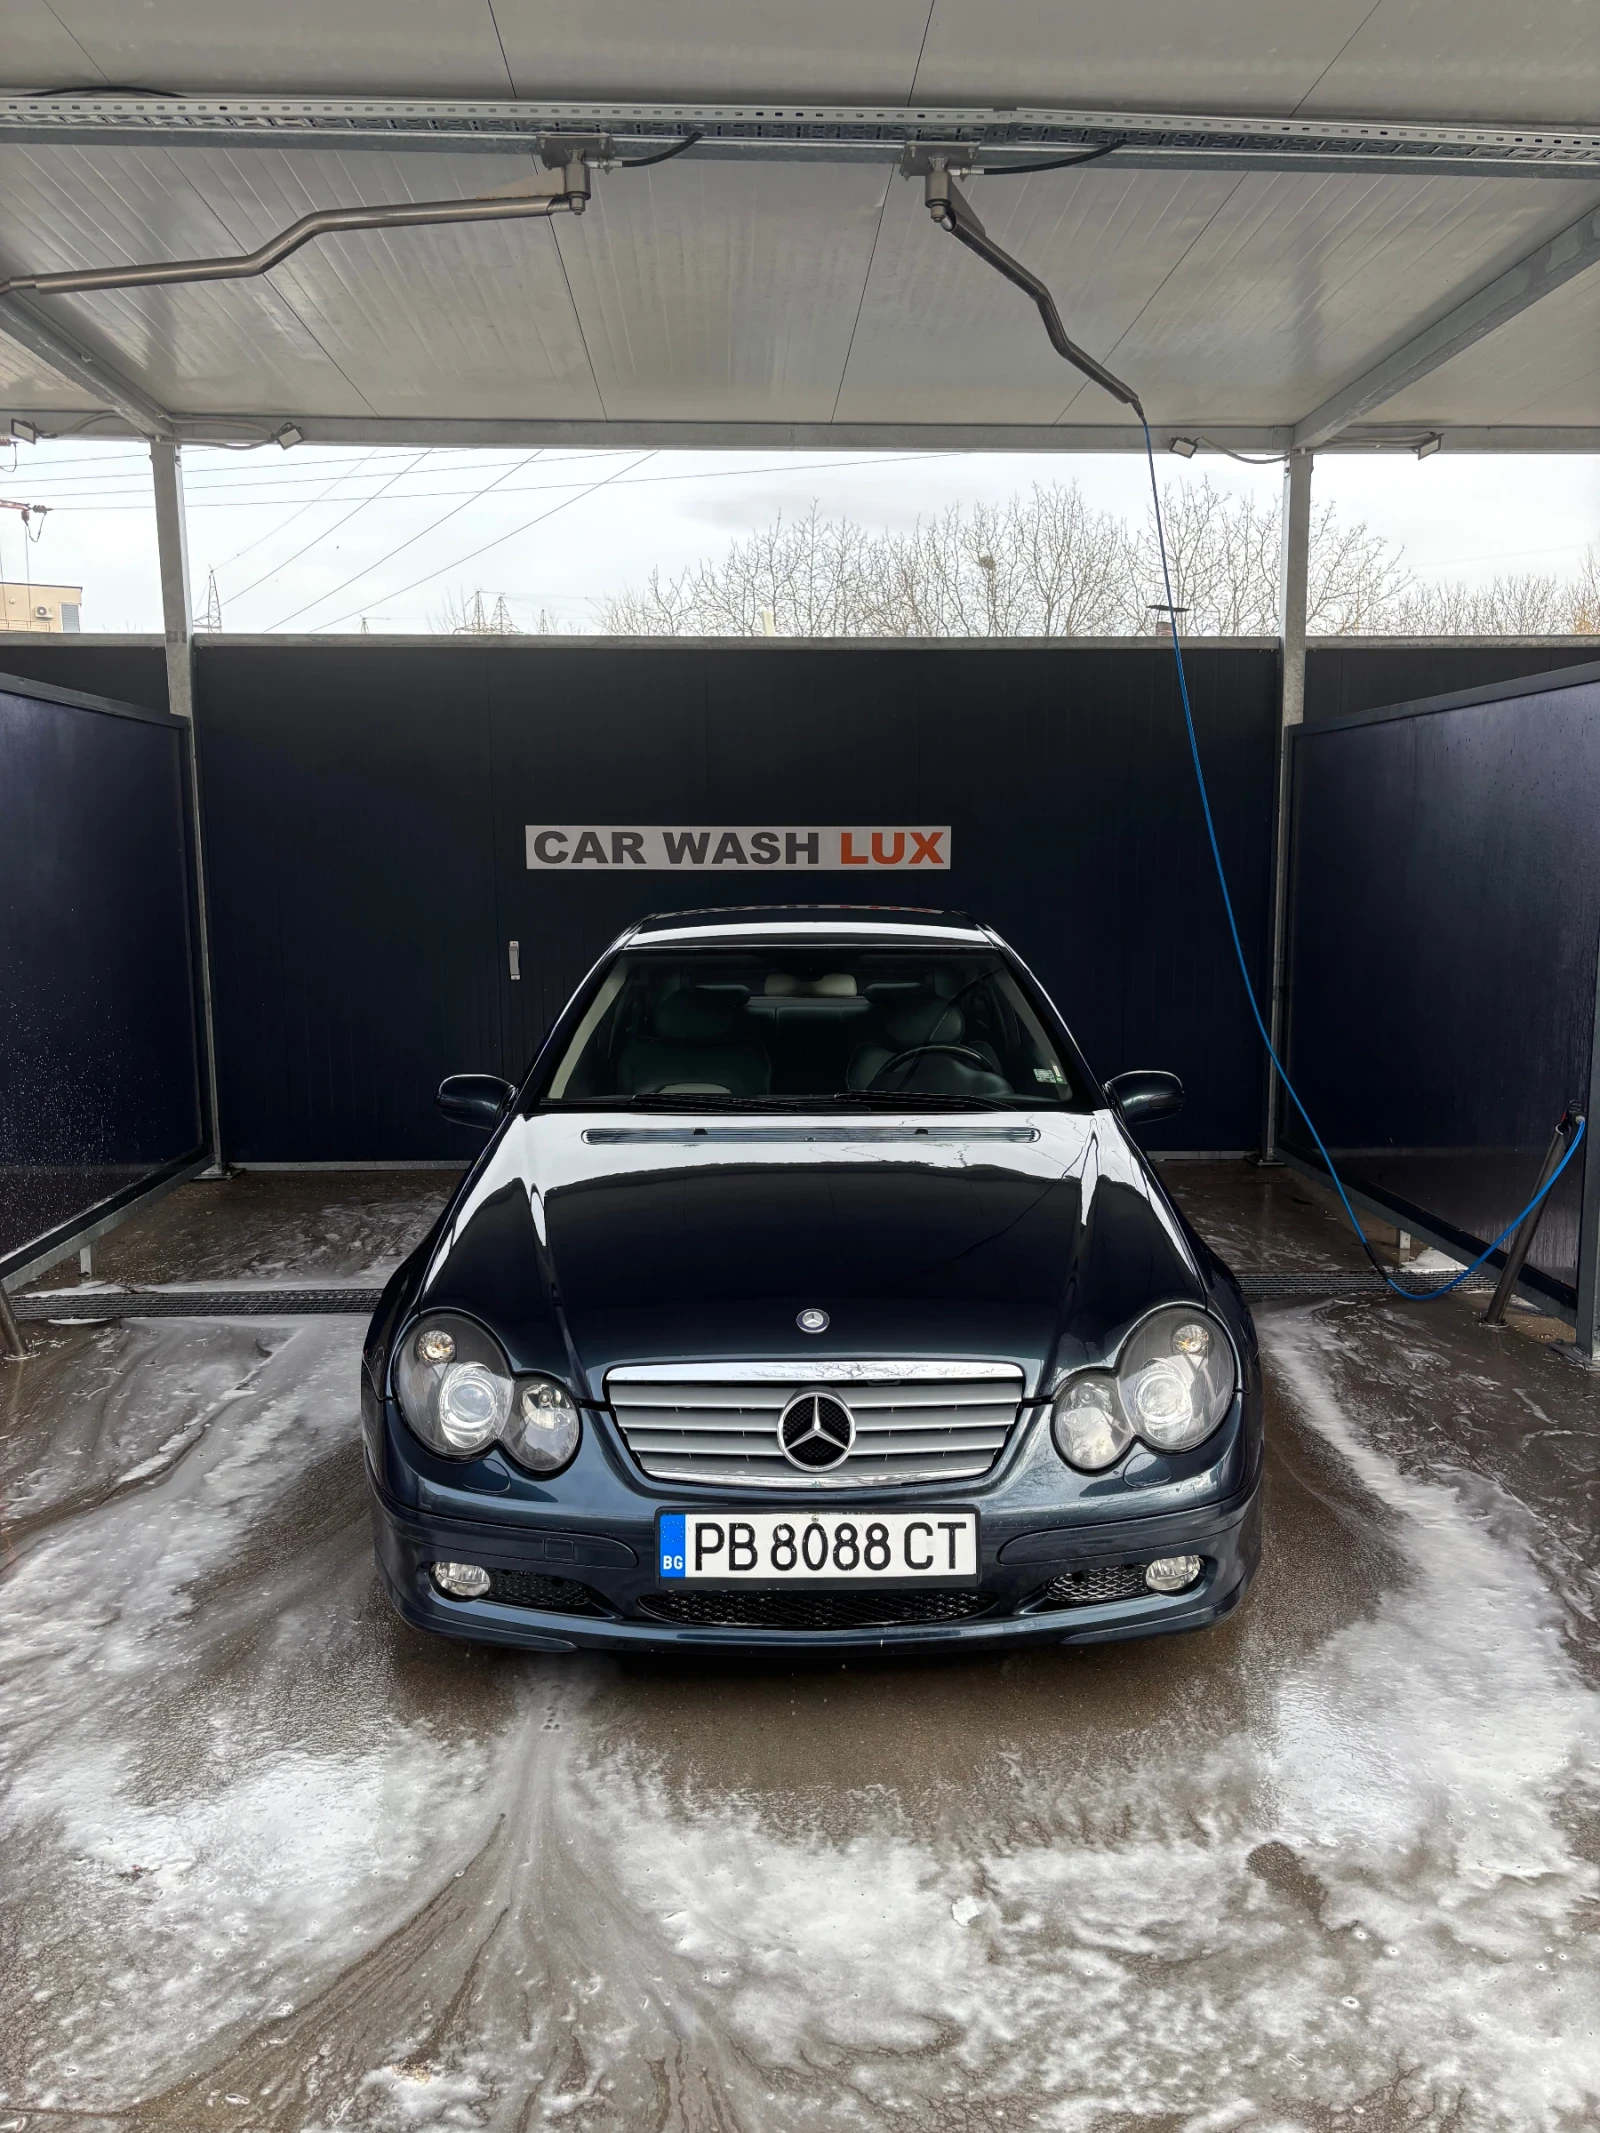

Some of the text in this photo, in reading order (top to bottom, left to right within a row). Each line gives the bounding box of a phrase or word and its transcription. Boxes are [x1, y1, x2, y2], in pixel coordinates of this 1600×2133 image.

[533, 831, 945, 865] CAR WASH LUX
[662, 1555, 684, 1570] BG
[694, 1521, 967, 1571] PB 8088 CT
